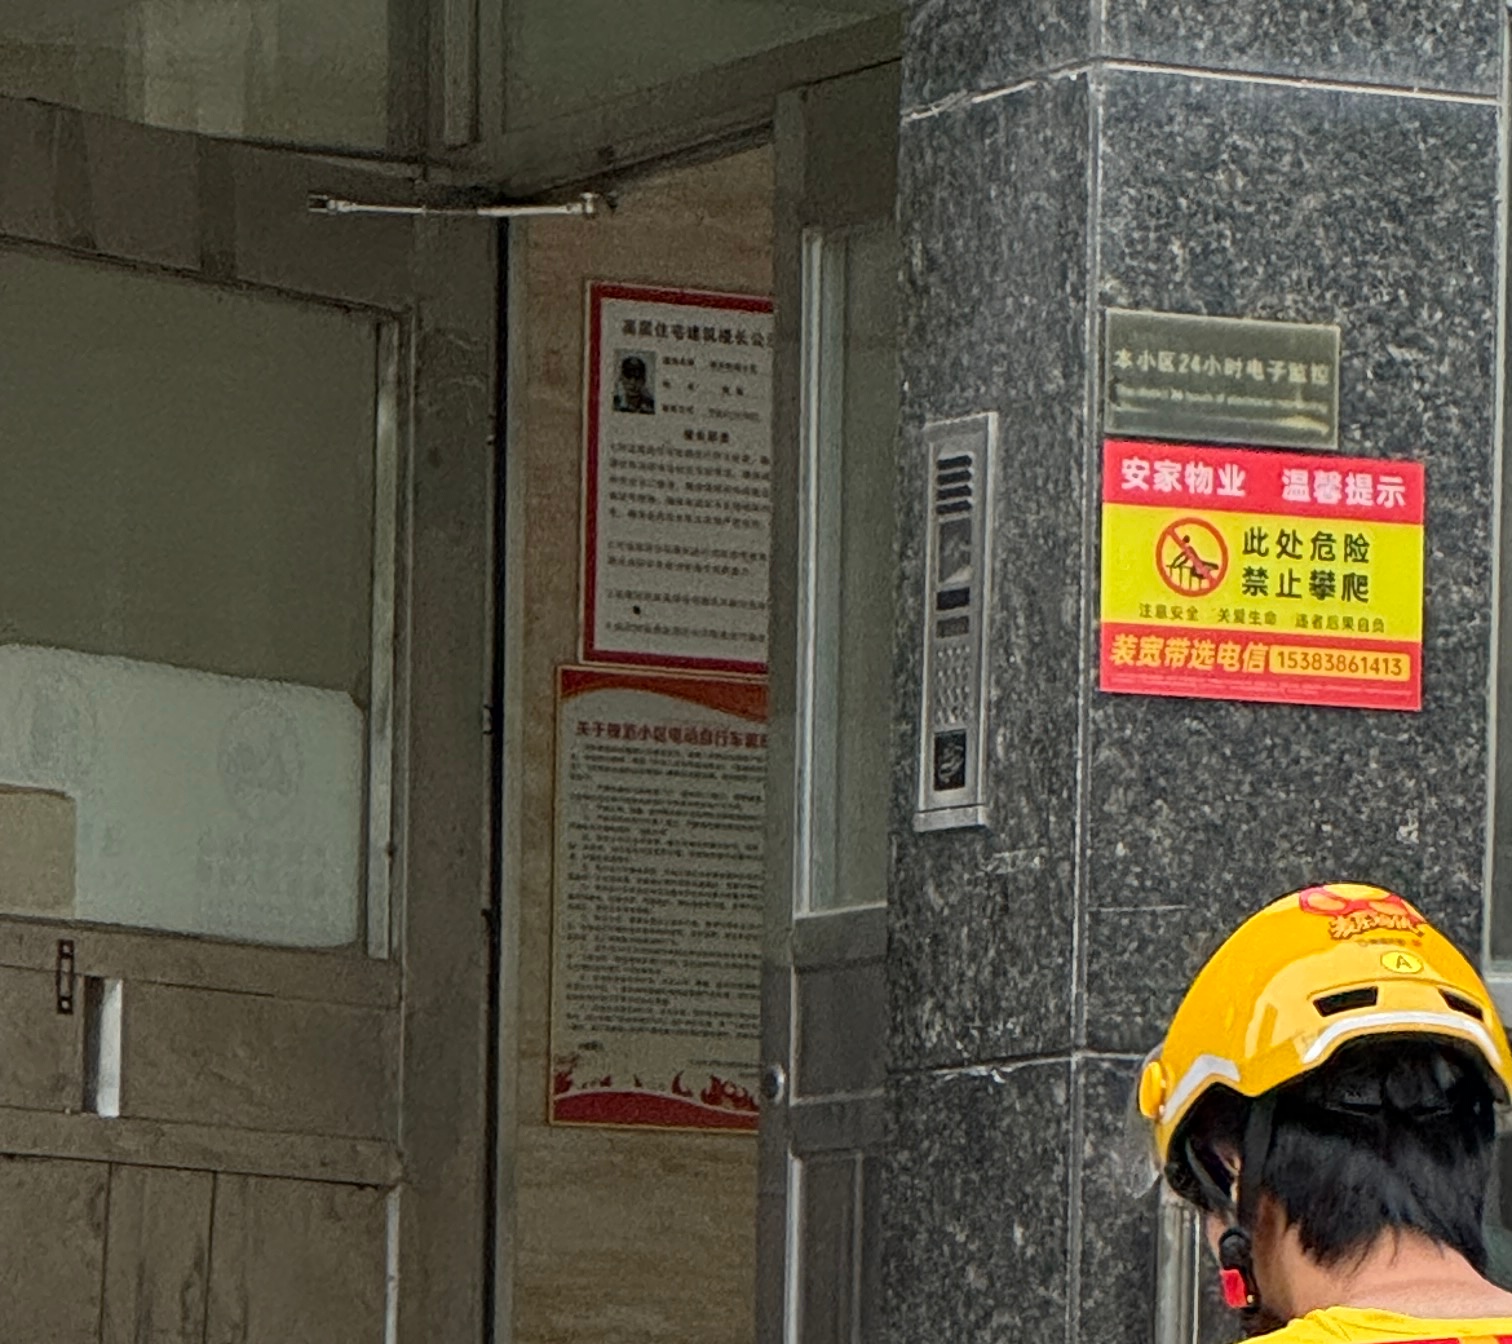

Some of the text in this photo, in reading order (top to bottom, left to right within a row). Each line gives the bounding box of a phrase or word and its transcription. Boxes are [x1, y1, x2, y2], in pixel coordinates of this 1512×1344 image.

[1113, 348, 1330, 385] 本小区24小时电子监控
[1121, 456, 1407, 508] 安家物业 温馨提示
[1242, 525, 1370, 564] 此处危险
[1241, 566, 1370, 604] 禁止攀爬
[1139, 602, 1385, 633] 注意安全 关爱生命 违者后果自负
[1111, 634, 1403, 676] 装宽带选电信 15383861413
